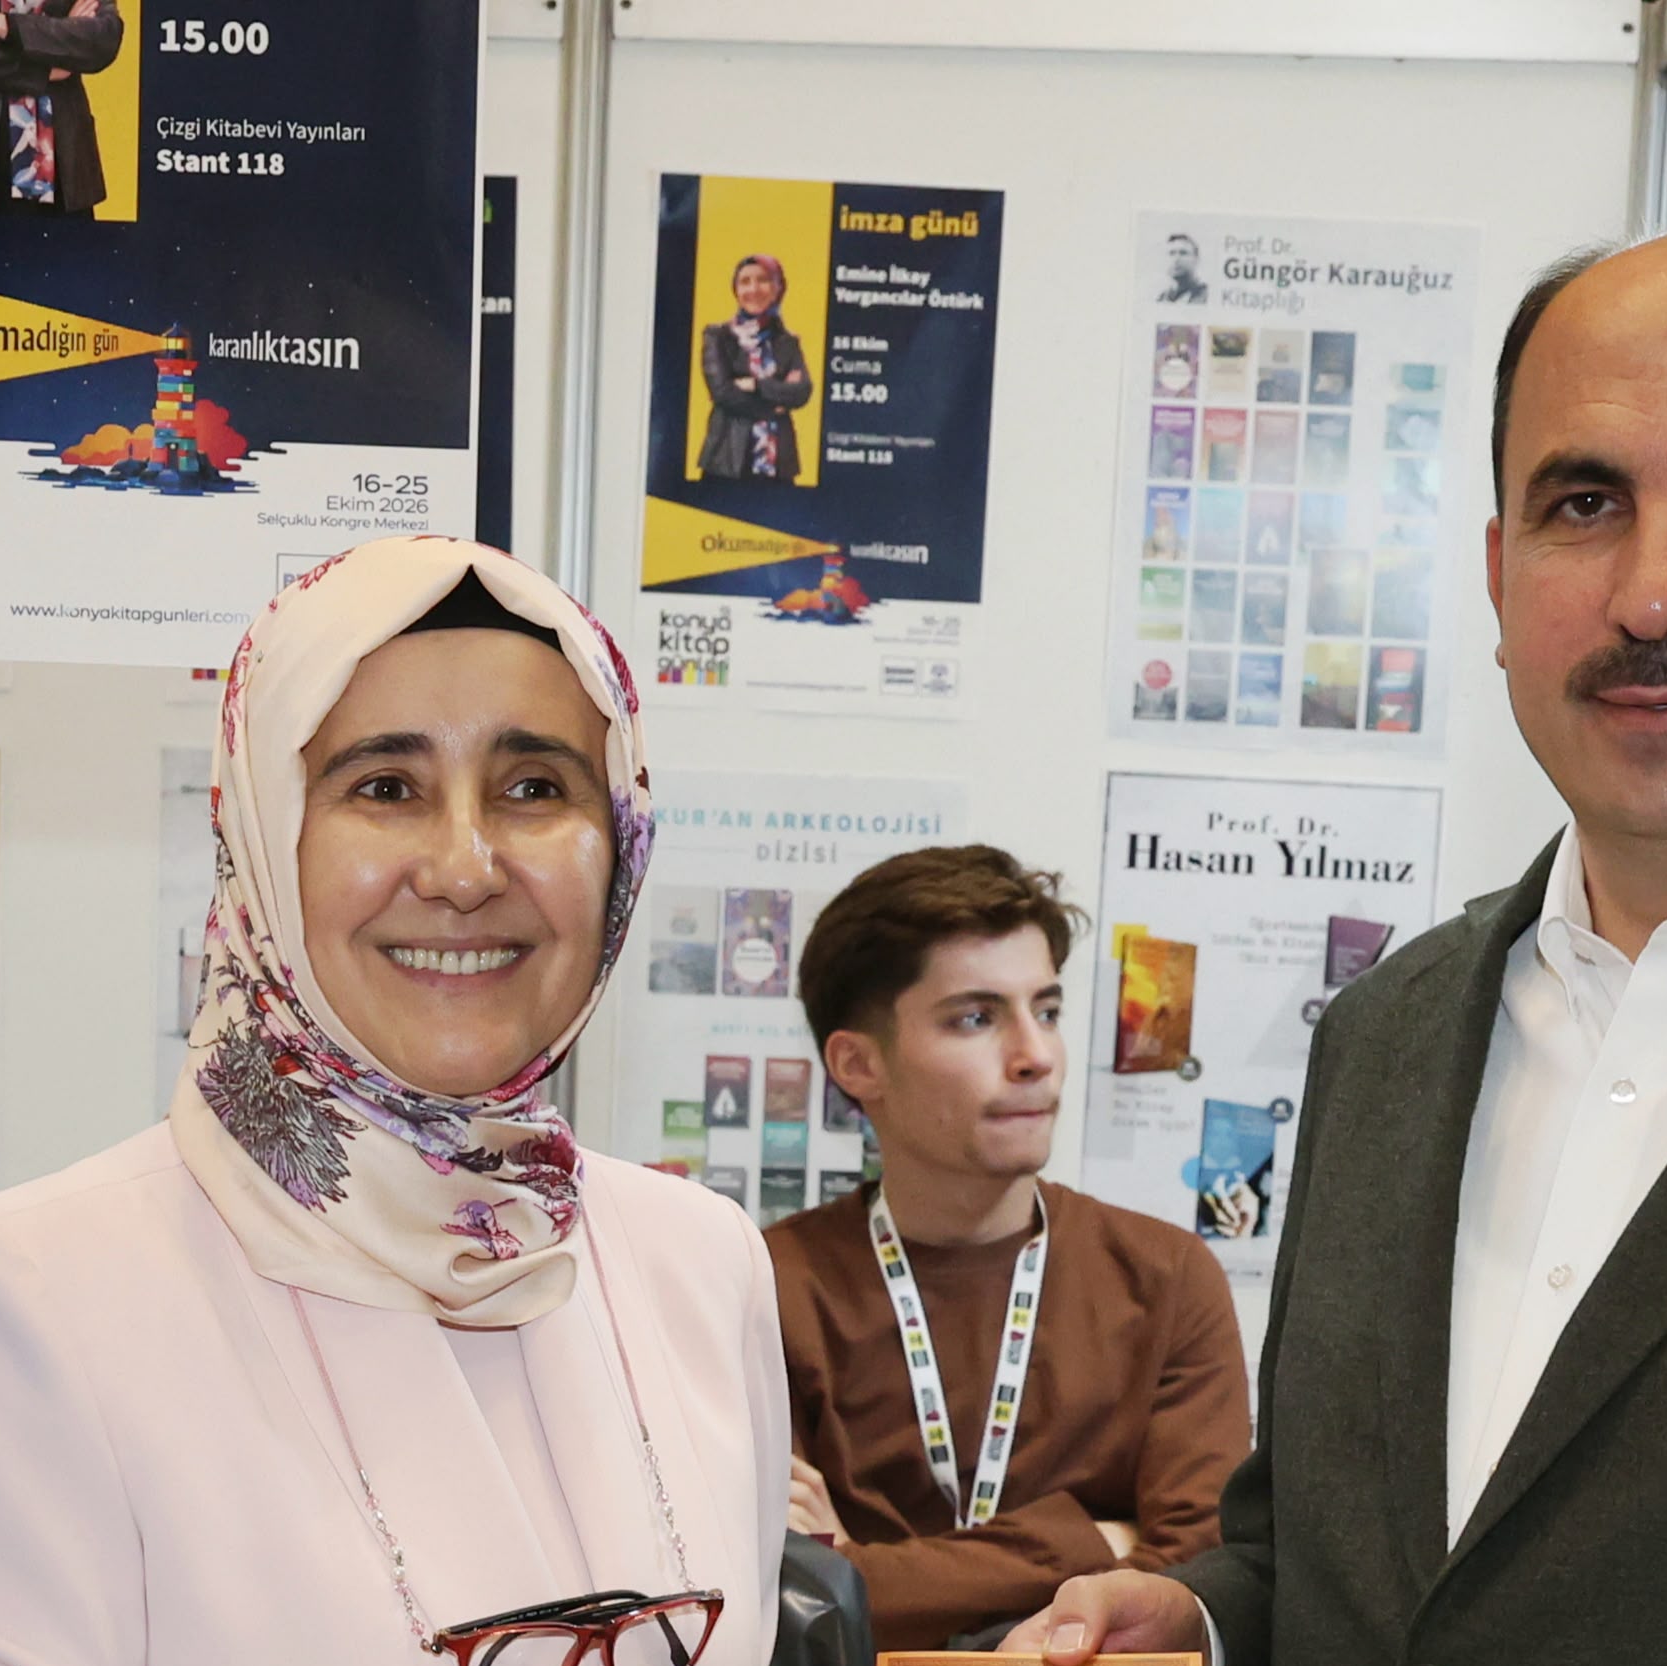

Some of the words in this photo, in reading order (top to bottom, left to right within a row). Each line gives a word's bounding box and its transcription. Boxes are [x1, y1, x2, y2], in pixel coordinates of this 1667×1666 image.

[159, 20, 270, 55] 15.00
[156, 116, 201, 140] Çizgi
[206, 119, 282, 139] Kitabevi
[286, 121, 366, 144] Yayınları
[156, 149, 230, 174] Stant
[237, 152, 285, 176] 118
[909, 209, 980, 241] günü
[1223, 256, 1321, 288] Güngör
[1327, 262, 1454, 294] Karauğuz
[93, 328, 120, 356] gün
[208, 330, 361, 370] karanlıktasın
[831, 356, 883, 375] Cuma
[829, 381, 889, 404] 15.00
[352, 473, 430, 496] 16-25
[325, 495, 375, 513] Ekim
[378, 497, 429, 514] 2026
[256, 511, 318, 529] Selçuklu
[319, 513, 372, 532] Kongre
[373, 517, 430, 532] Merkezi
[10, 602, 251, 624] www.konyakitapgunleri.com
[659, 609, 733, 638] konya
[658, 630, 731, 656] kitap
[764, 811, 943, 835] ARKEOLOJİSİ
[1207, 811, 1280, 835] Prof.
[755, 839, 839, 864] DİZİSİ
[1124, 832, 1255, 877] Hasan
[1275, 838, 1416, 885] Yılmaz
